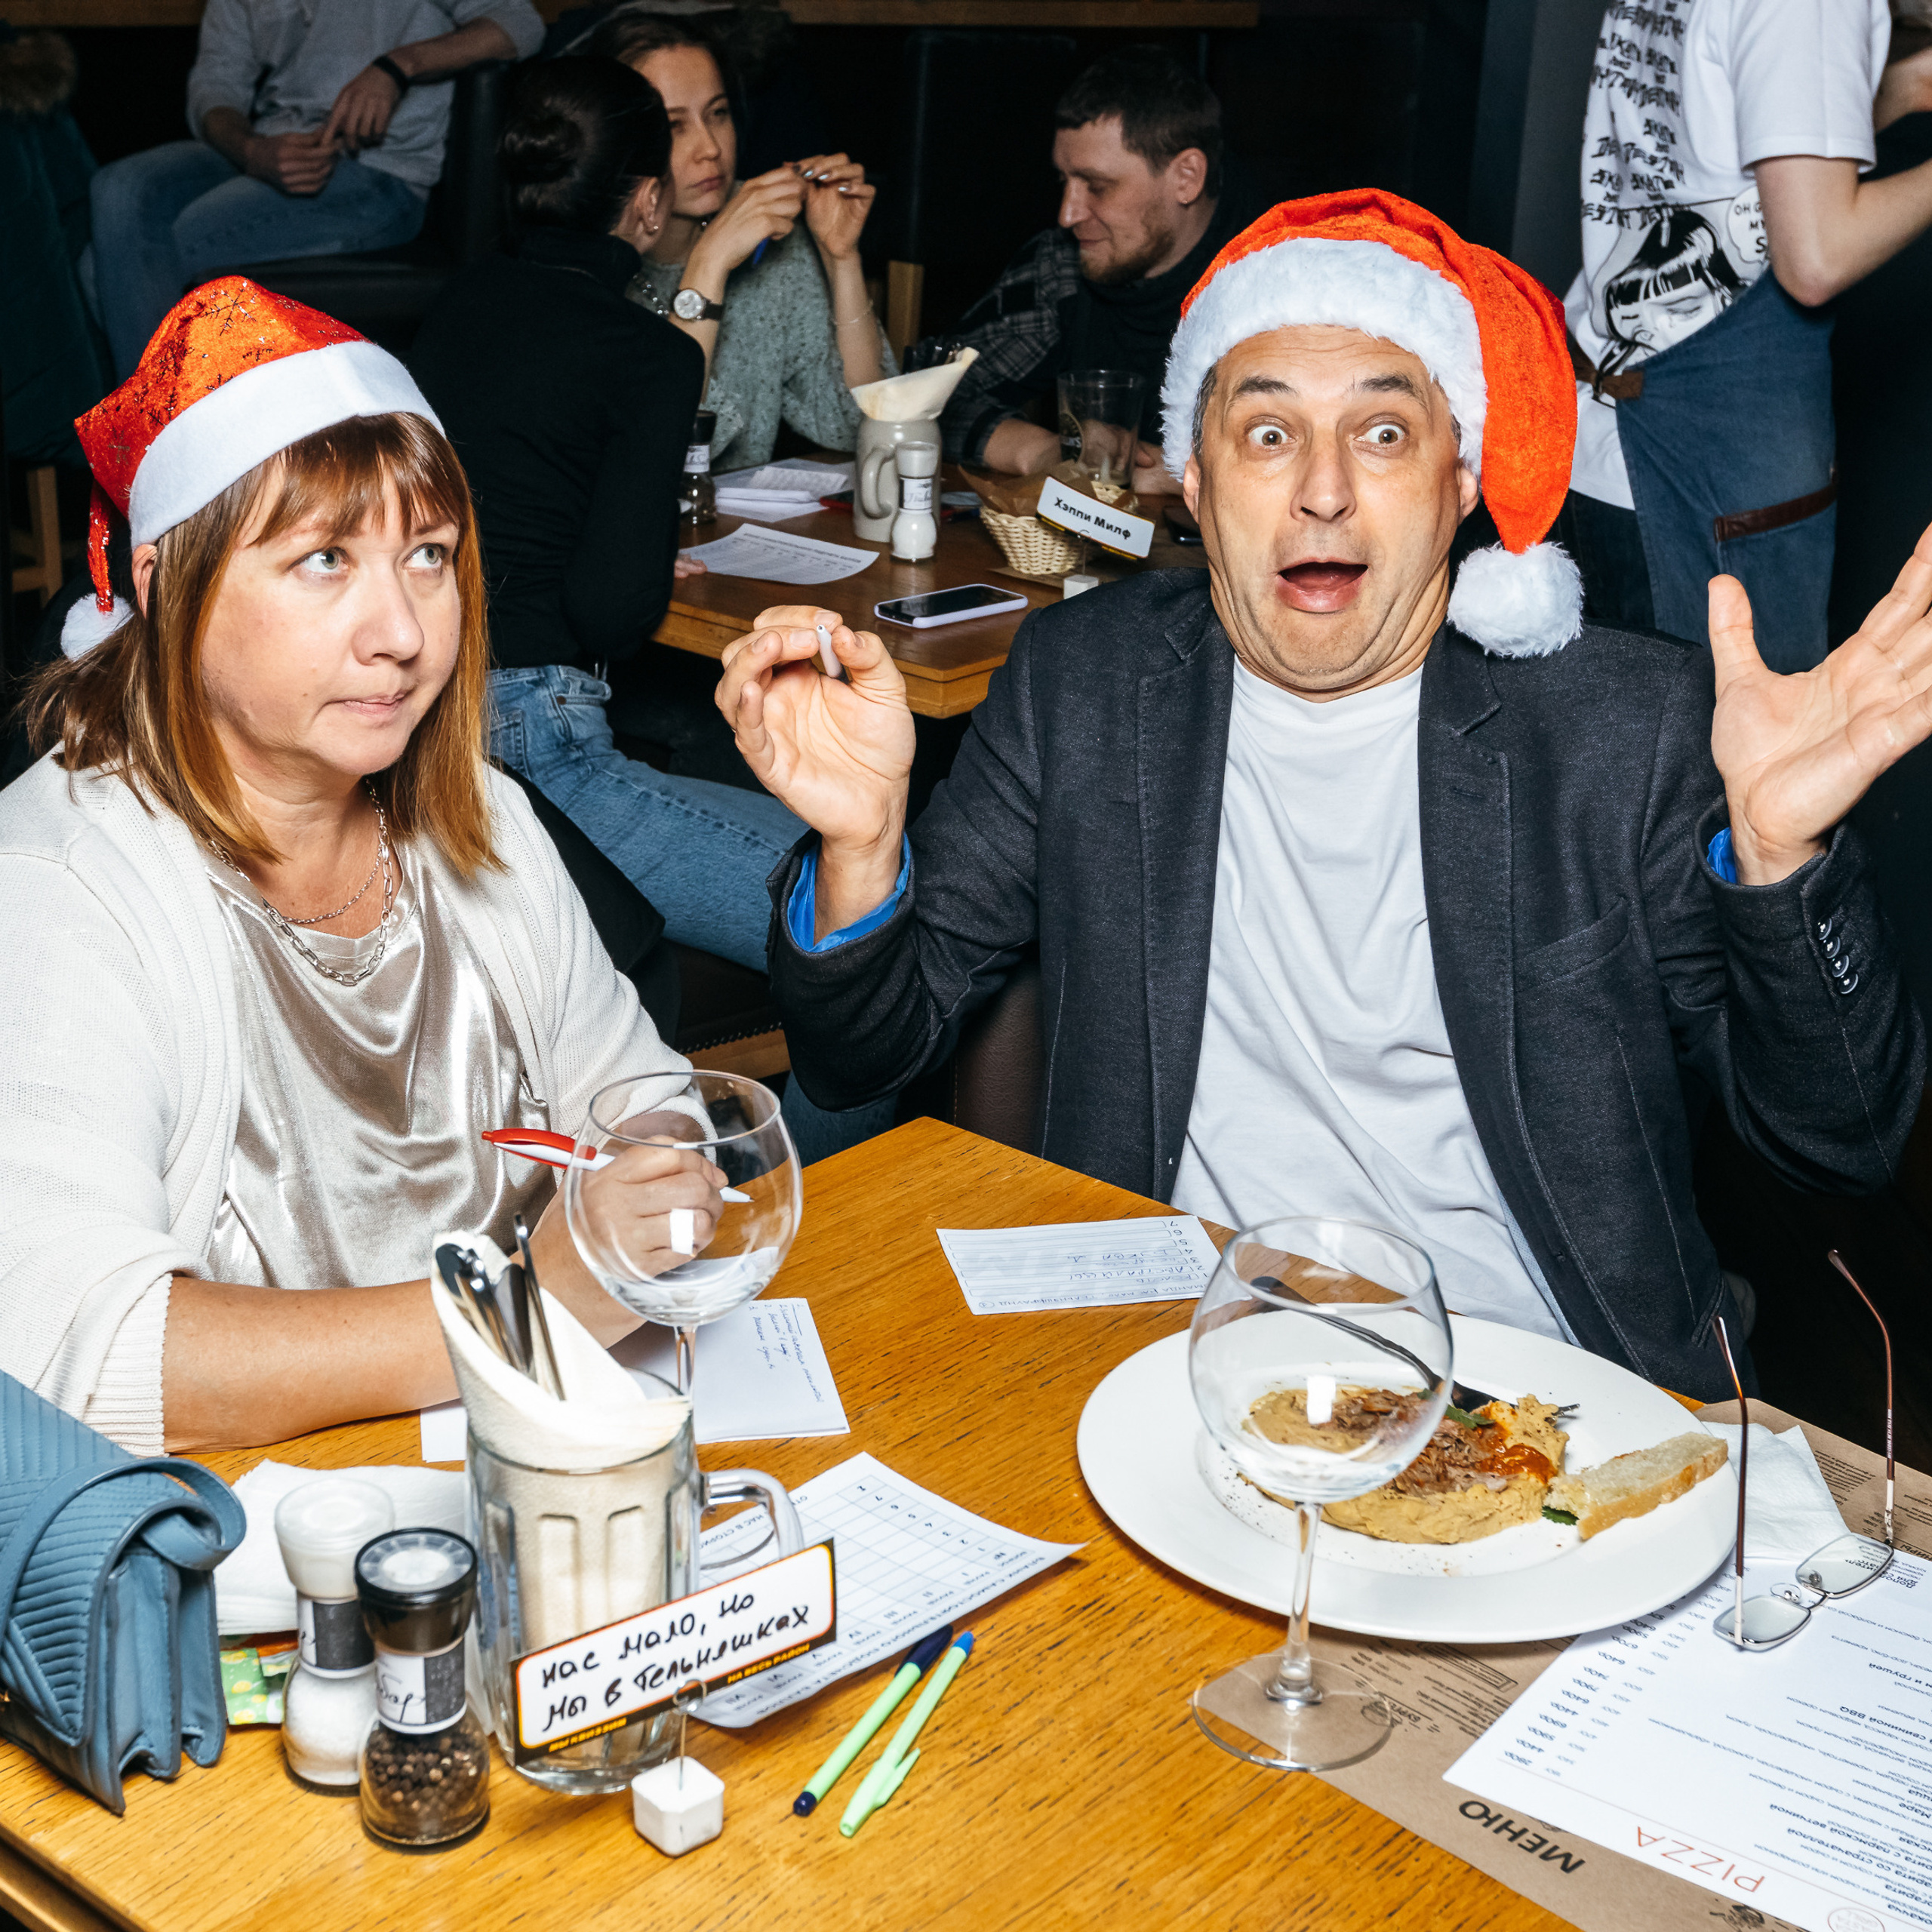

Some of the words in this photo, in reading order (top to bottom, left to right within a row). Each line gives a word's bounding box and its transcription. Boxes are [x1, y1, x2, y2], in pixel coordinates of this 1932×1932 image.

[1054, 497, 1091, 522] Хэппи
[1094, 516, 1131, 540] Милф
[1868, 1663, 1912, 1681] грушей
[1839, 1706, 1866, 1719] BBQ
[1869, 1716, 1926, 1740] свининой
[1769, 1803, 1826, 1829] ветчиной
[1898, 1802, 1931, 1819] Маре
[1457, 1798, 1586, 1875] МЕНЮ
[1829, 1826, 1890, 1854] пармской
[1635, 1825, 1766, 1894] PIZZA
